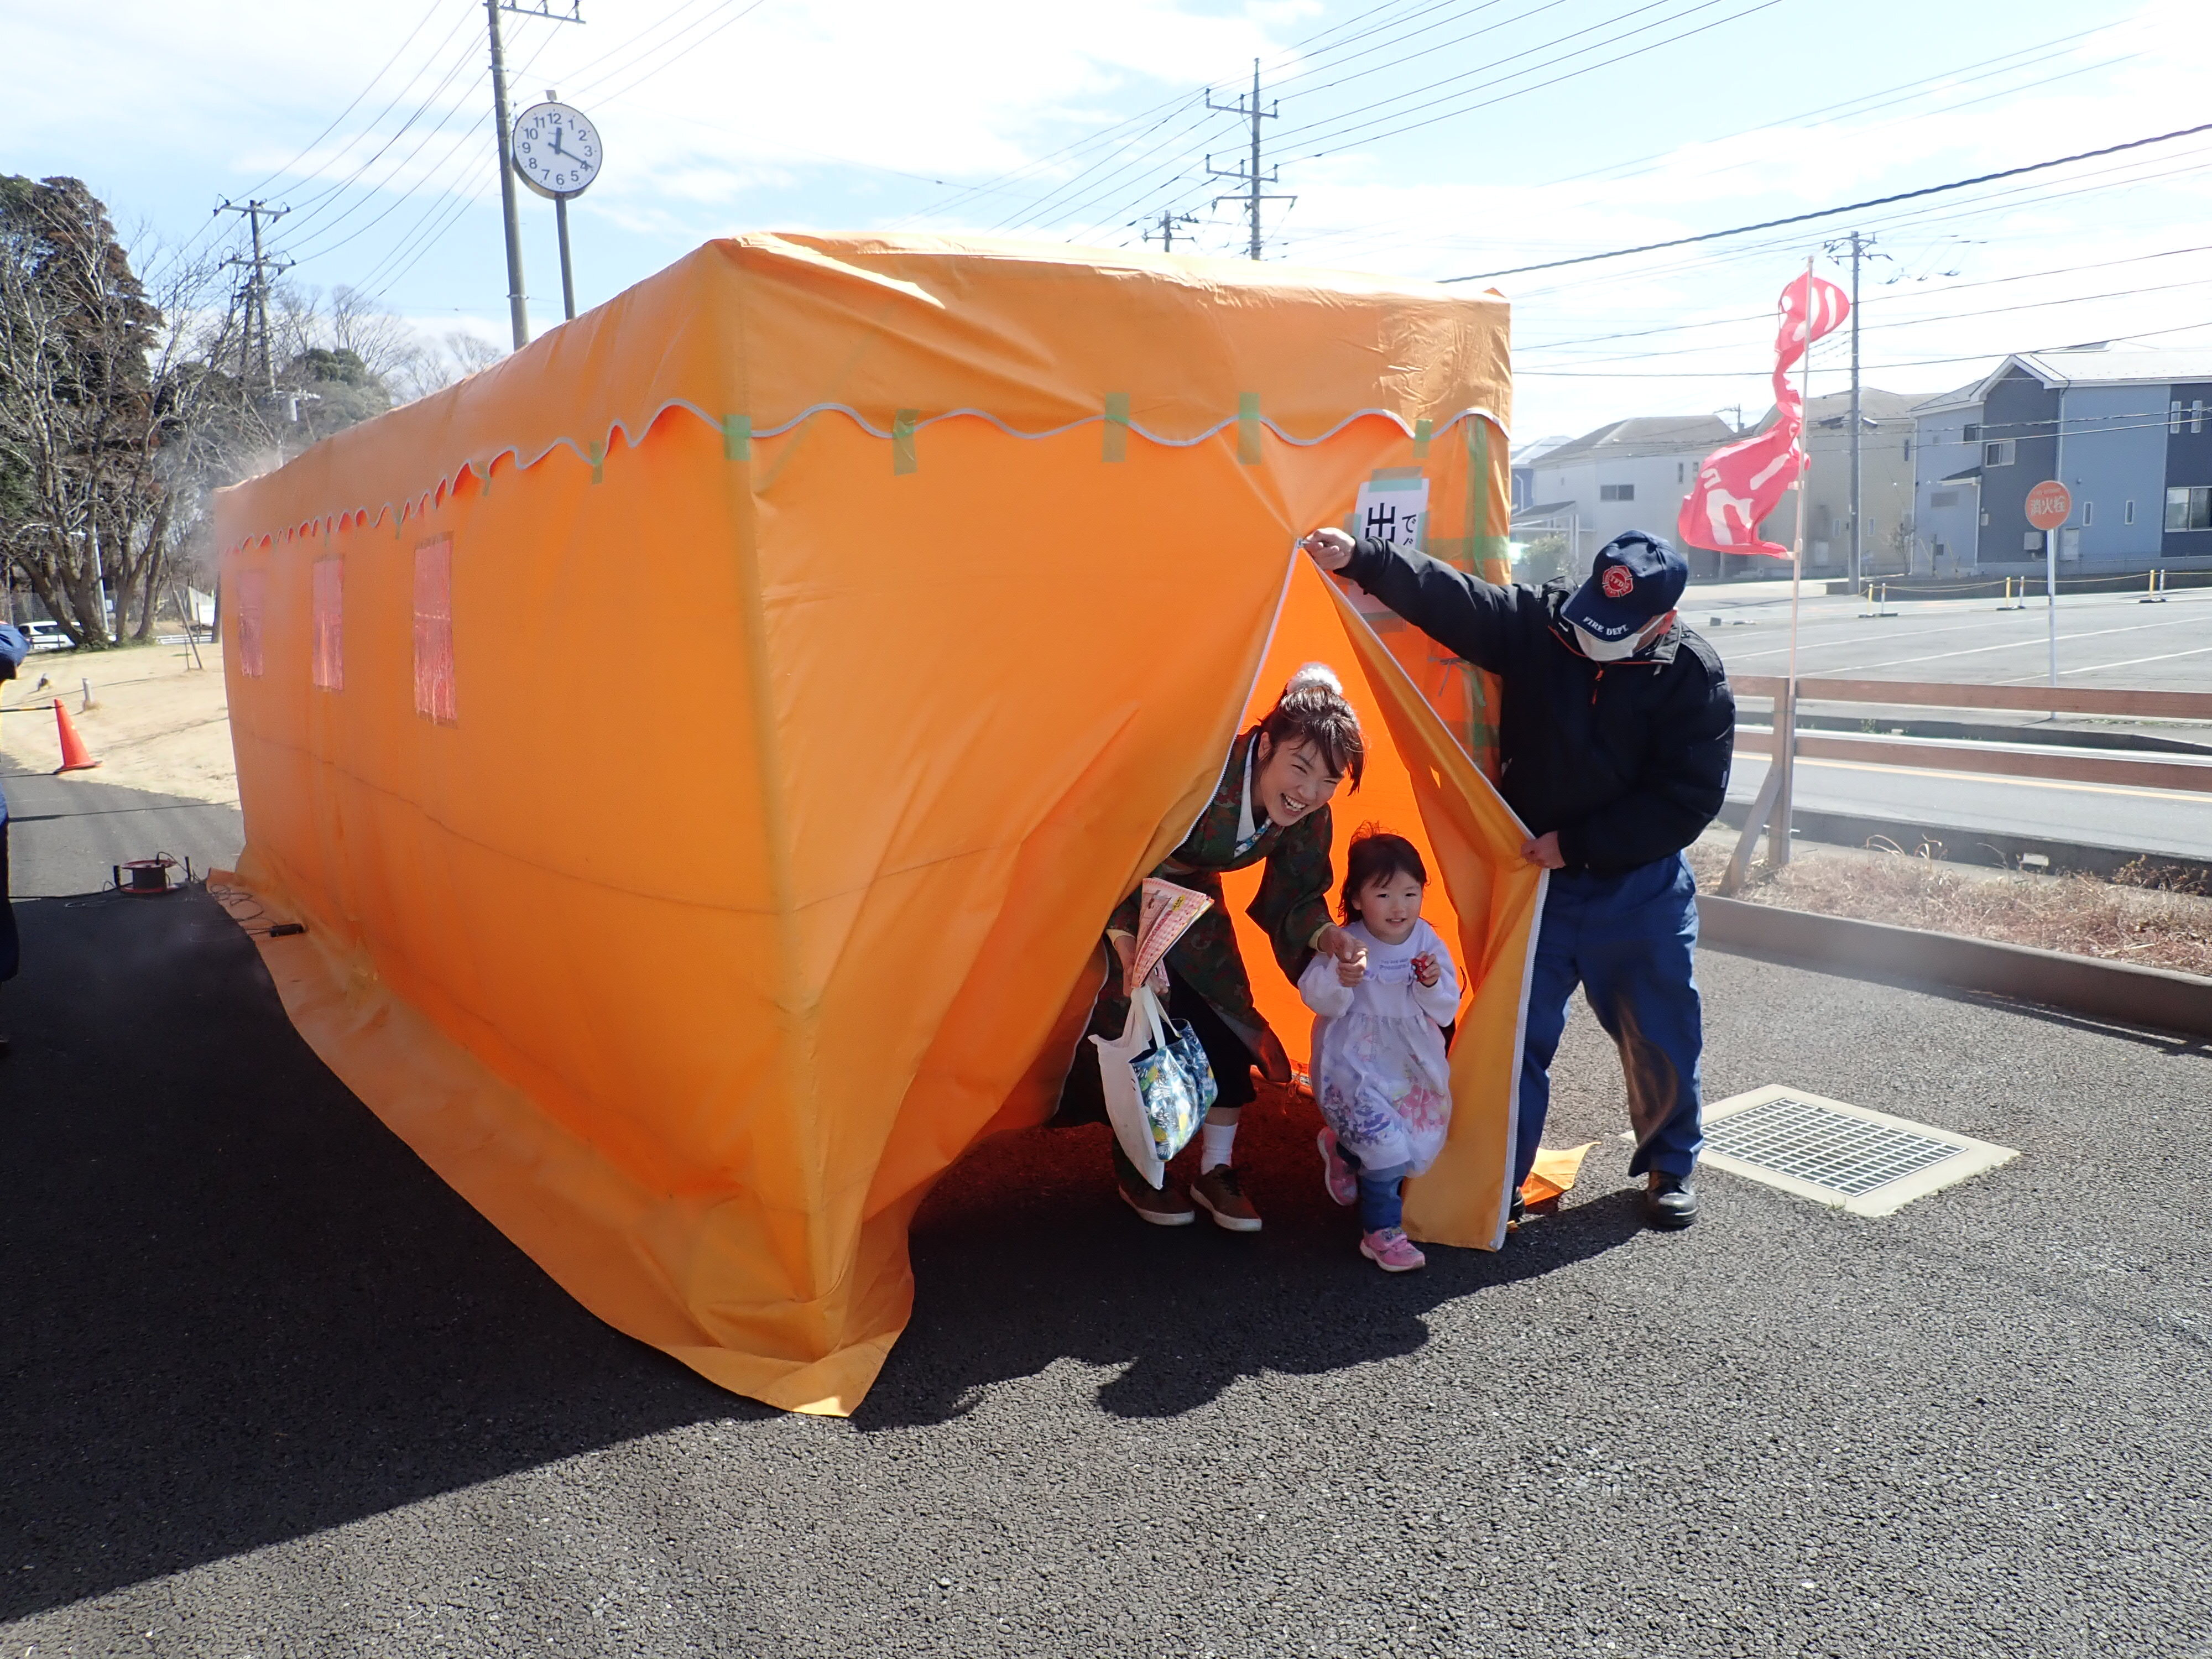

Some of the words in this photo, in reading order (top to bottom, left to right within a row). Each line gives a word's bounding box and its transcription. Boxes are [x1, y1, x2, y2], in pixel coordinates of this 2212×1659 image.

[534, 117, 545, 128] 11
[547, 113, 561, 124] 12
[568, 119, 573, 130] 1
[524, 128, 538, 140] 10
[578, 130, 587, 141] 2
[522, 142, 531, 154] 9
[584, 145, 592, 157] 3
[529, 158, 538, 169] 8
[541, 169, 550, 180] 7
[556, 174, 564, 185] 6
[571, 170, 579, 181] 5
[2030, 495, 2065, 515] 消火栓
[1583, 616, 1604, 633] FIRE
